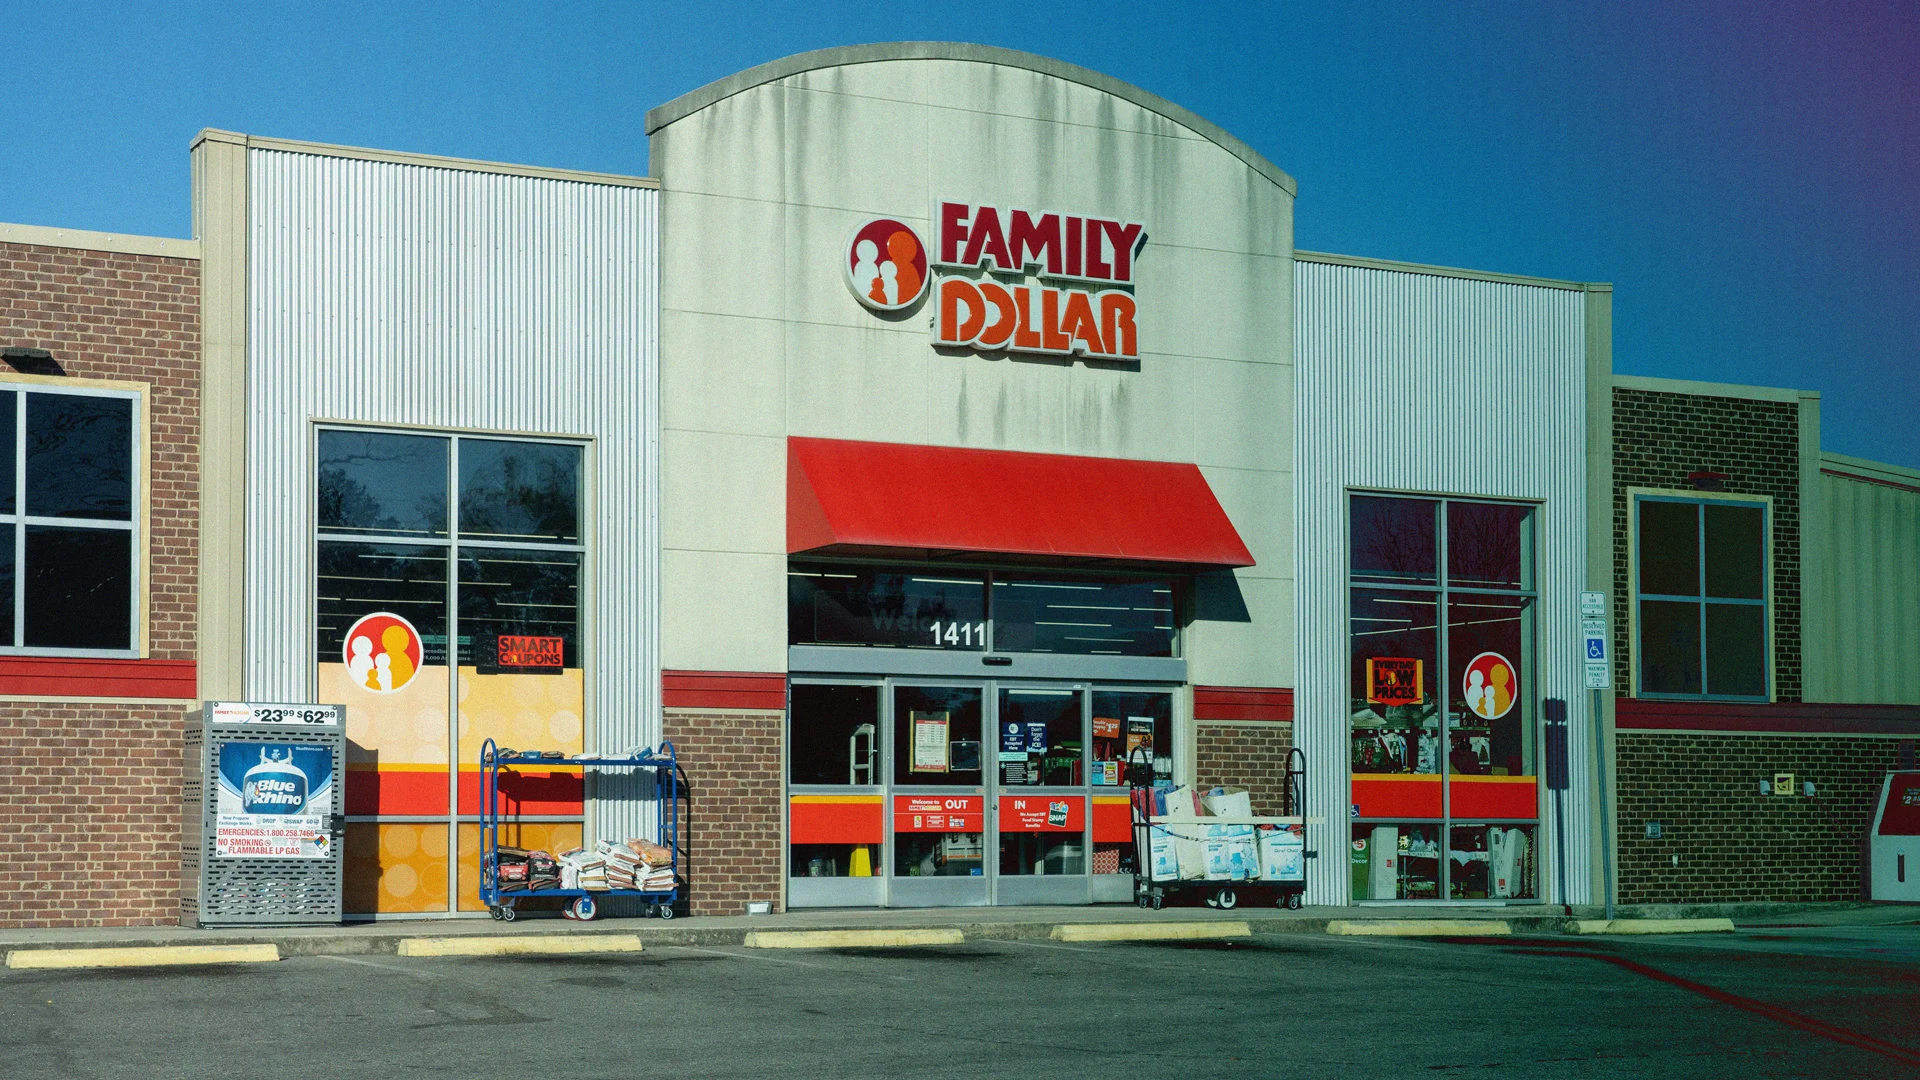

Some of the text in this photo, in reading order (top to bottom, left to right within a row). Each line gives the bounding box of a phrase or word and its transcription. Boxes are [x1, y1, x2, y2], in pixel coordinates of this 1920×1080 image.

[941, 202, 1142, 281] FAMILY
[941, 280, 1137, 356] DOLLAR
[930, 621, 984, 646] 1411
[500, 637, 561, 653] SMART
[500, 653, 561, 664] COUPONS
[1375, 669, 1415, 686] LOW
[1375, 686, 1415, 699] PRICES
[257, 779, 295, 792] Blue
[253, 792, 302, 806] Rhino
[945, 800, 968, 809] OUT
[1014, 800, 1026, 810] IN
[218, 838, 228, 846] NO
[229, 838, 264, 846] SMOKING
[228, 846, 273, 854] FLAMMABLE
[285, 847, 300, 855] GAS
